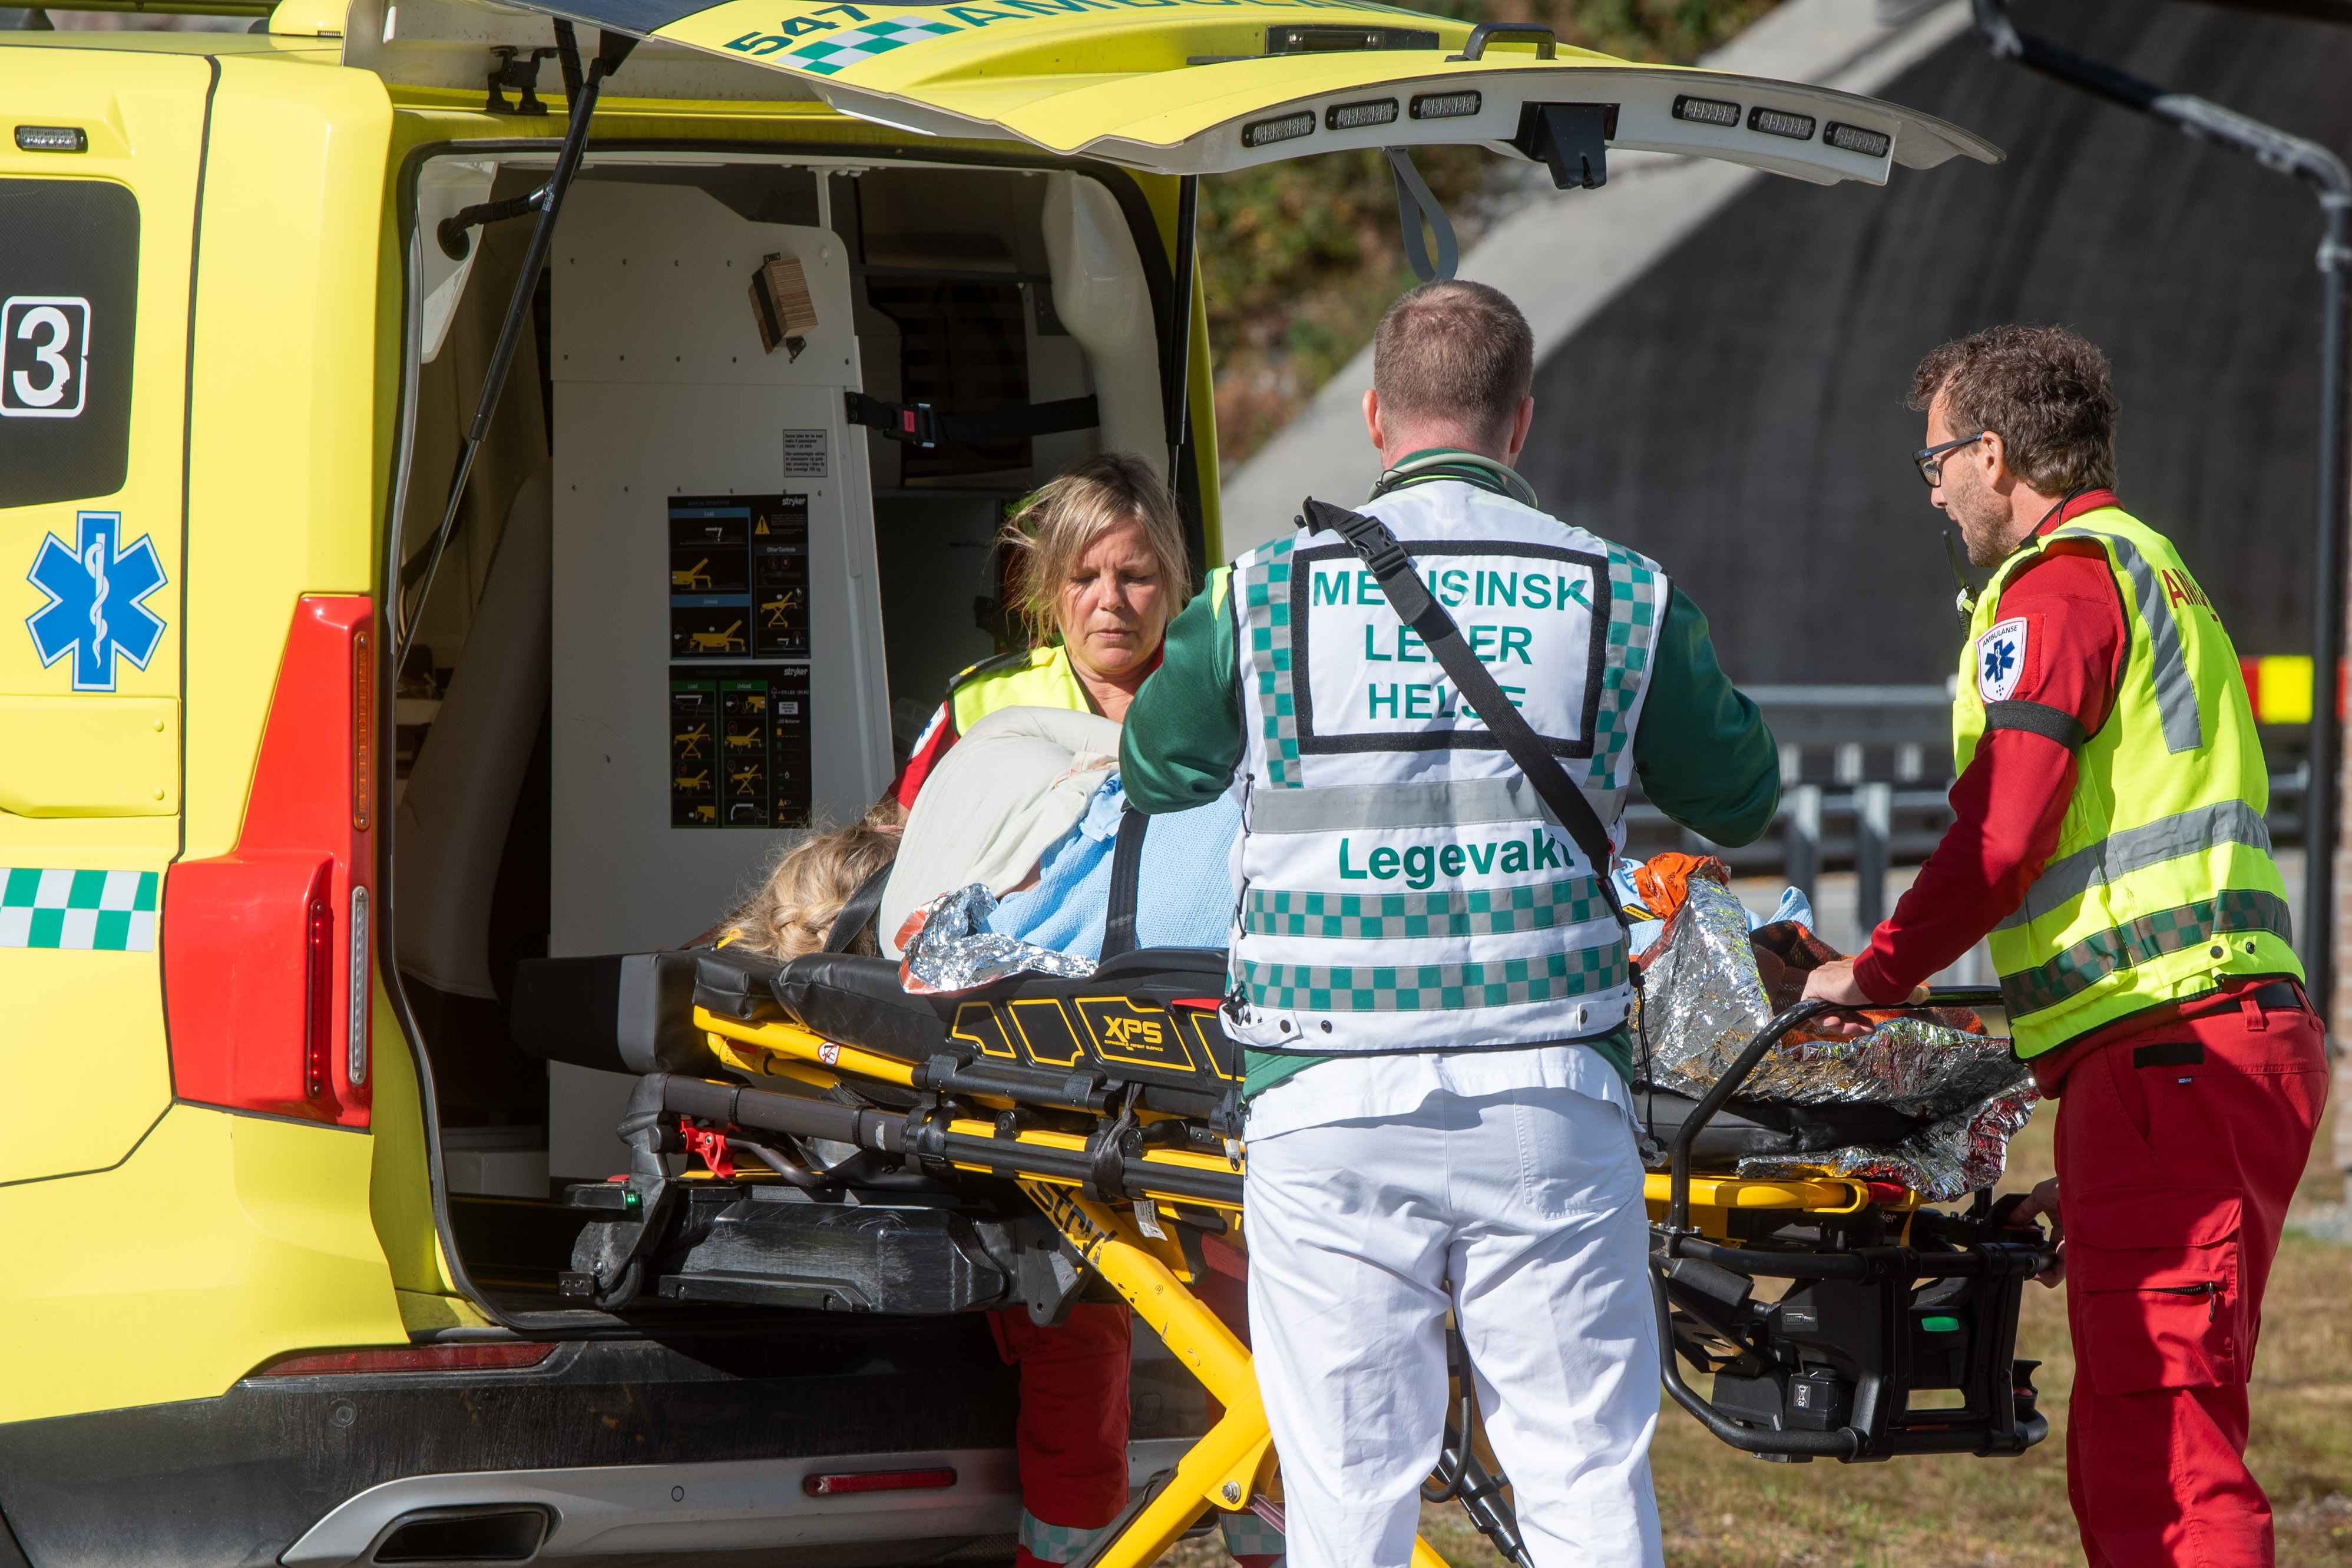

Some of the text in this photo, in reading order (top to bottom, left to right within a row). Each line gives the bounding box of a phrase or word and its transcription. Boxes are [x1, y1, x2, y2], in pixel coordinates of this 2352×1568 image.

[722, 4, 871, 55] 547
[13, 306, 70, 407] 3
[782, 496, 806, 507] stryker
[1314, 570, 1589, 610] MEISINSK
[1365, 624, 1533, 665] LEER
[1983, 624, 2018, 647] AMBULANSE
[783, 667, 808, 677] stryker
[1103, 1015, 1162, 1051] XPS
